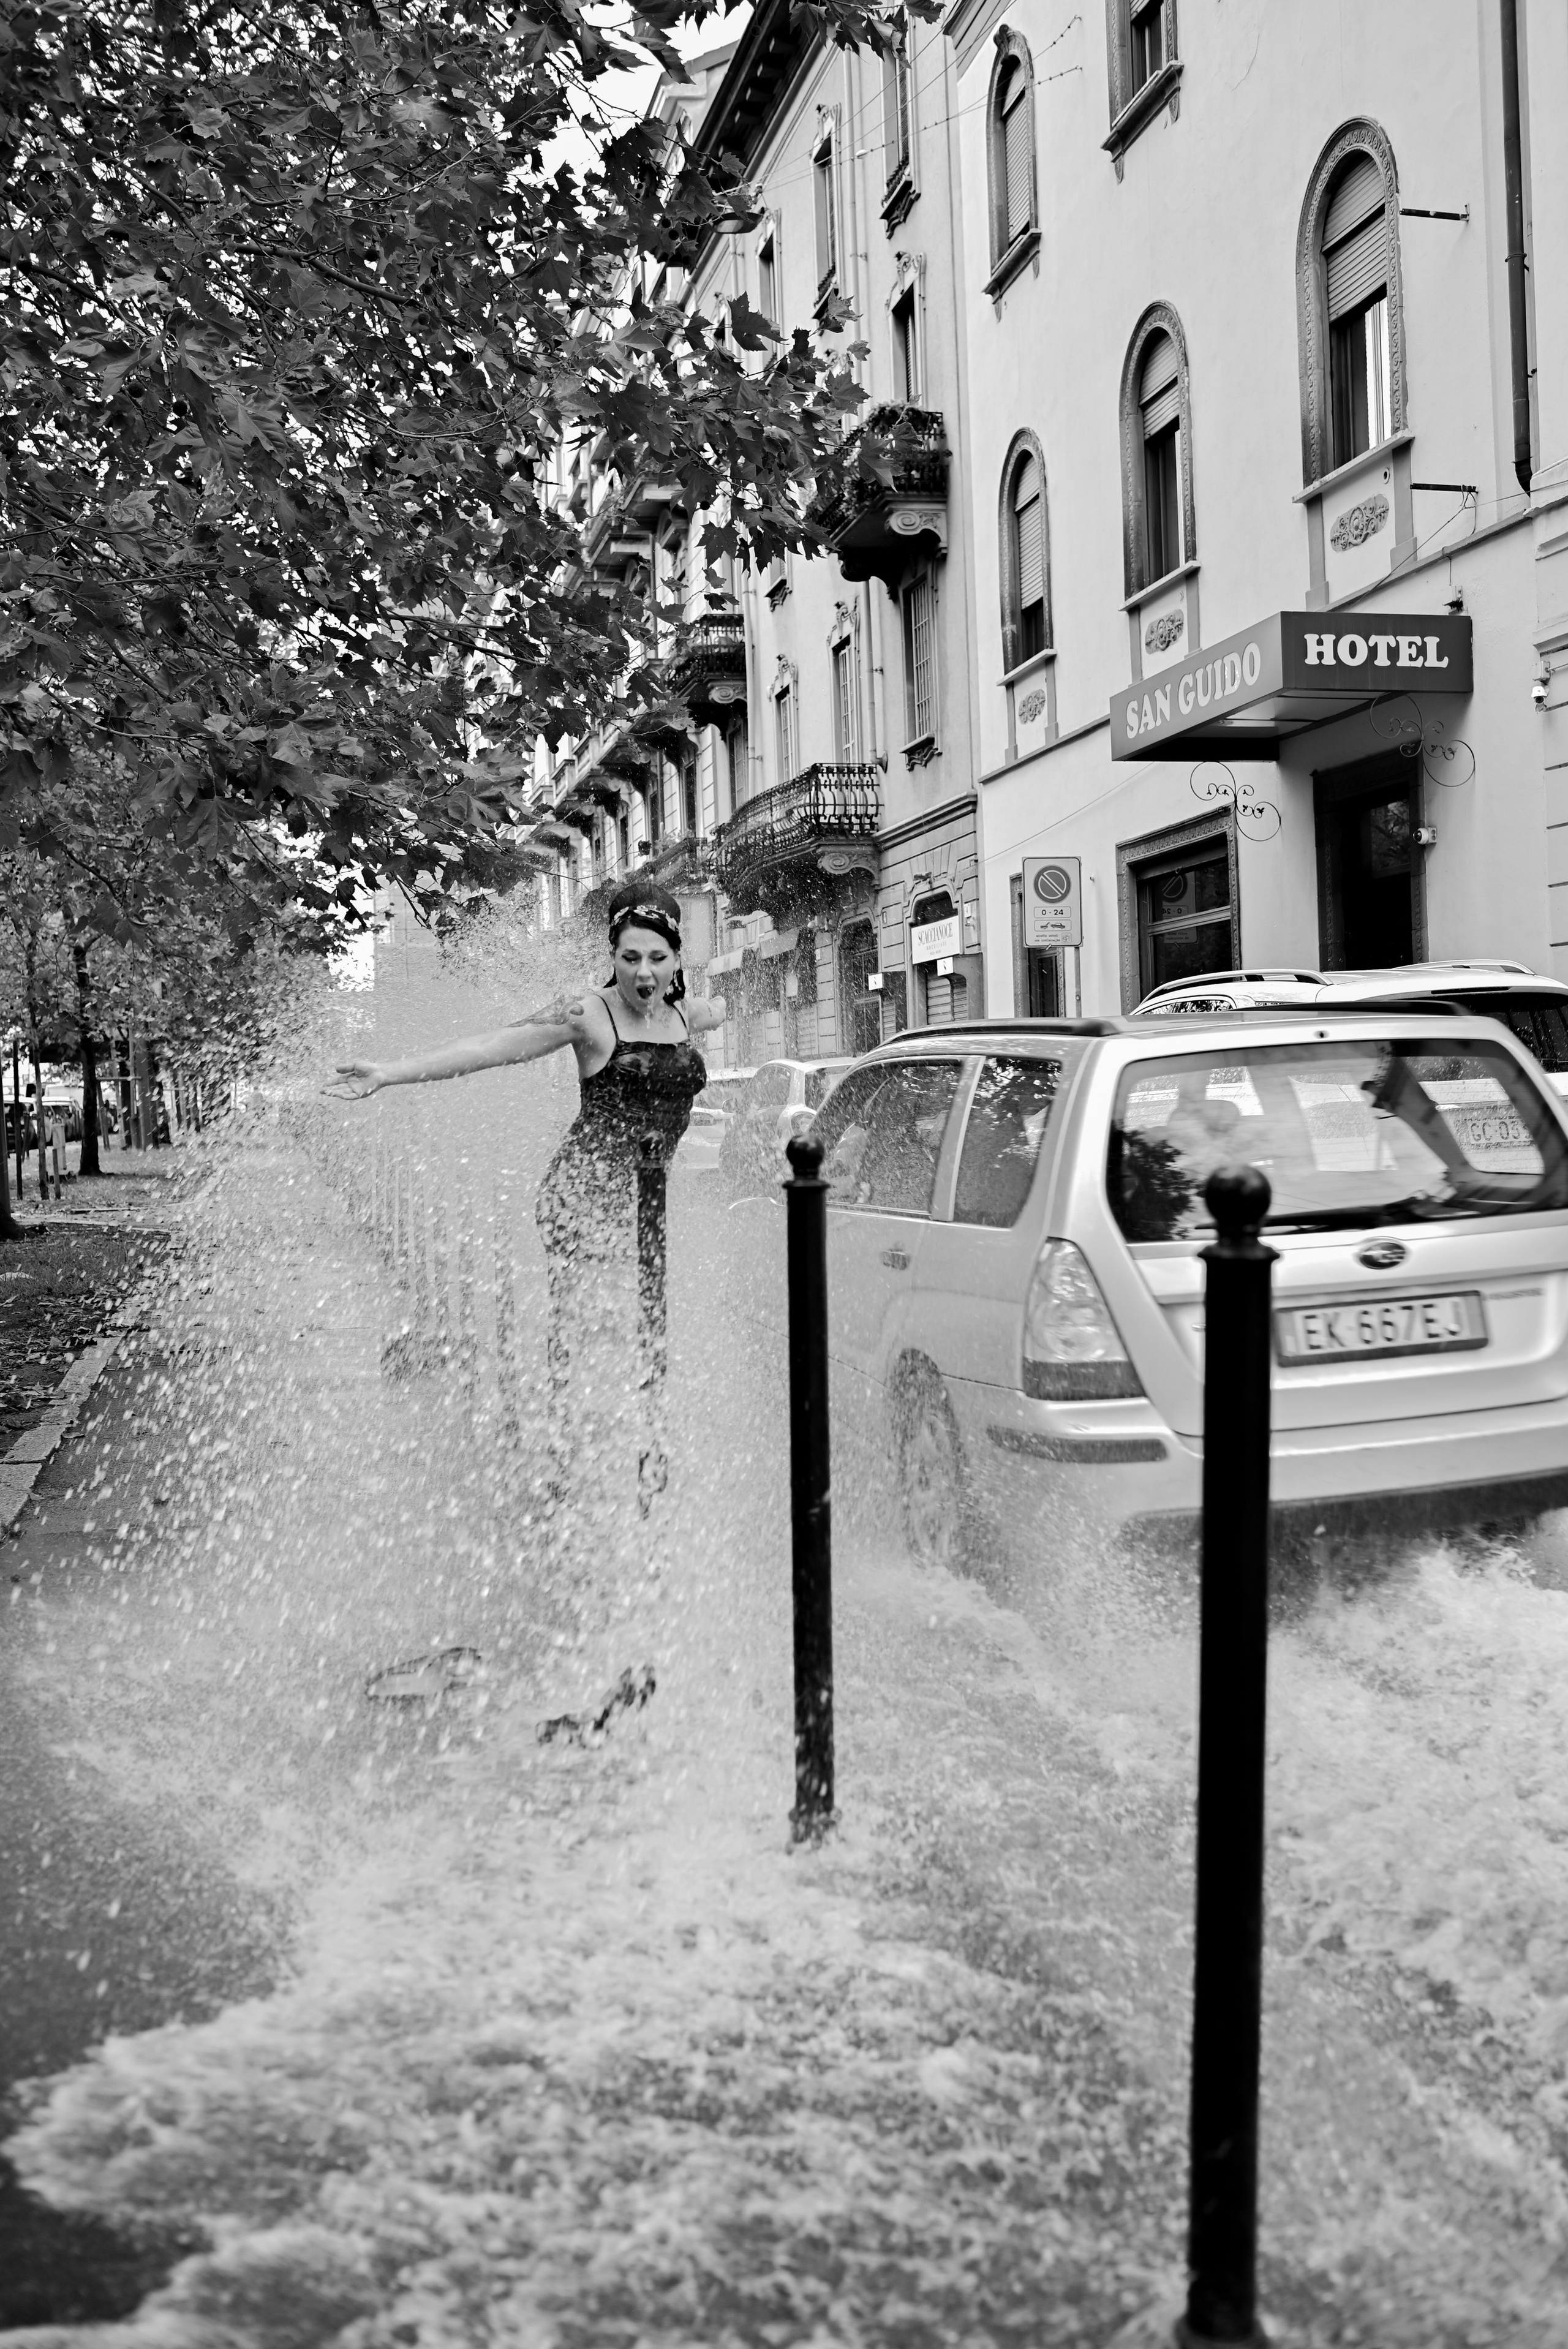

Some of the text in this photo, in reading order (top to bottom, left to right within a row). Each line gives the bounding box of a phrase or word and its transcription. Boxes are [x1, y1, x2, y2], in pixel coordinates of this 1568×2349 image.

[1303, 633, 1449, 668] HOTEL
[1126, 641, 1261, 739] SAN GUIDO
[1304, 1297, 1461, 1350] EK 667EJ
